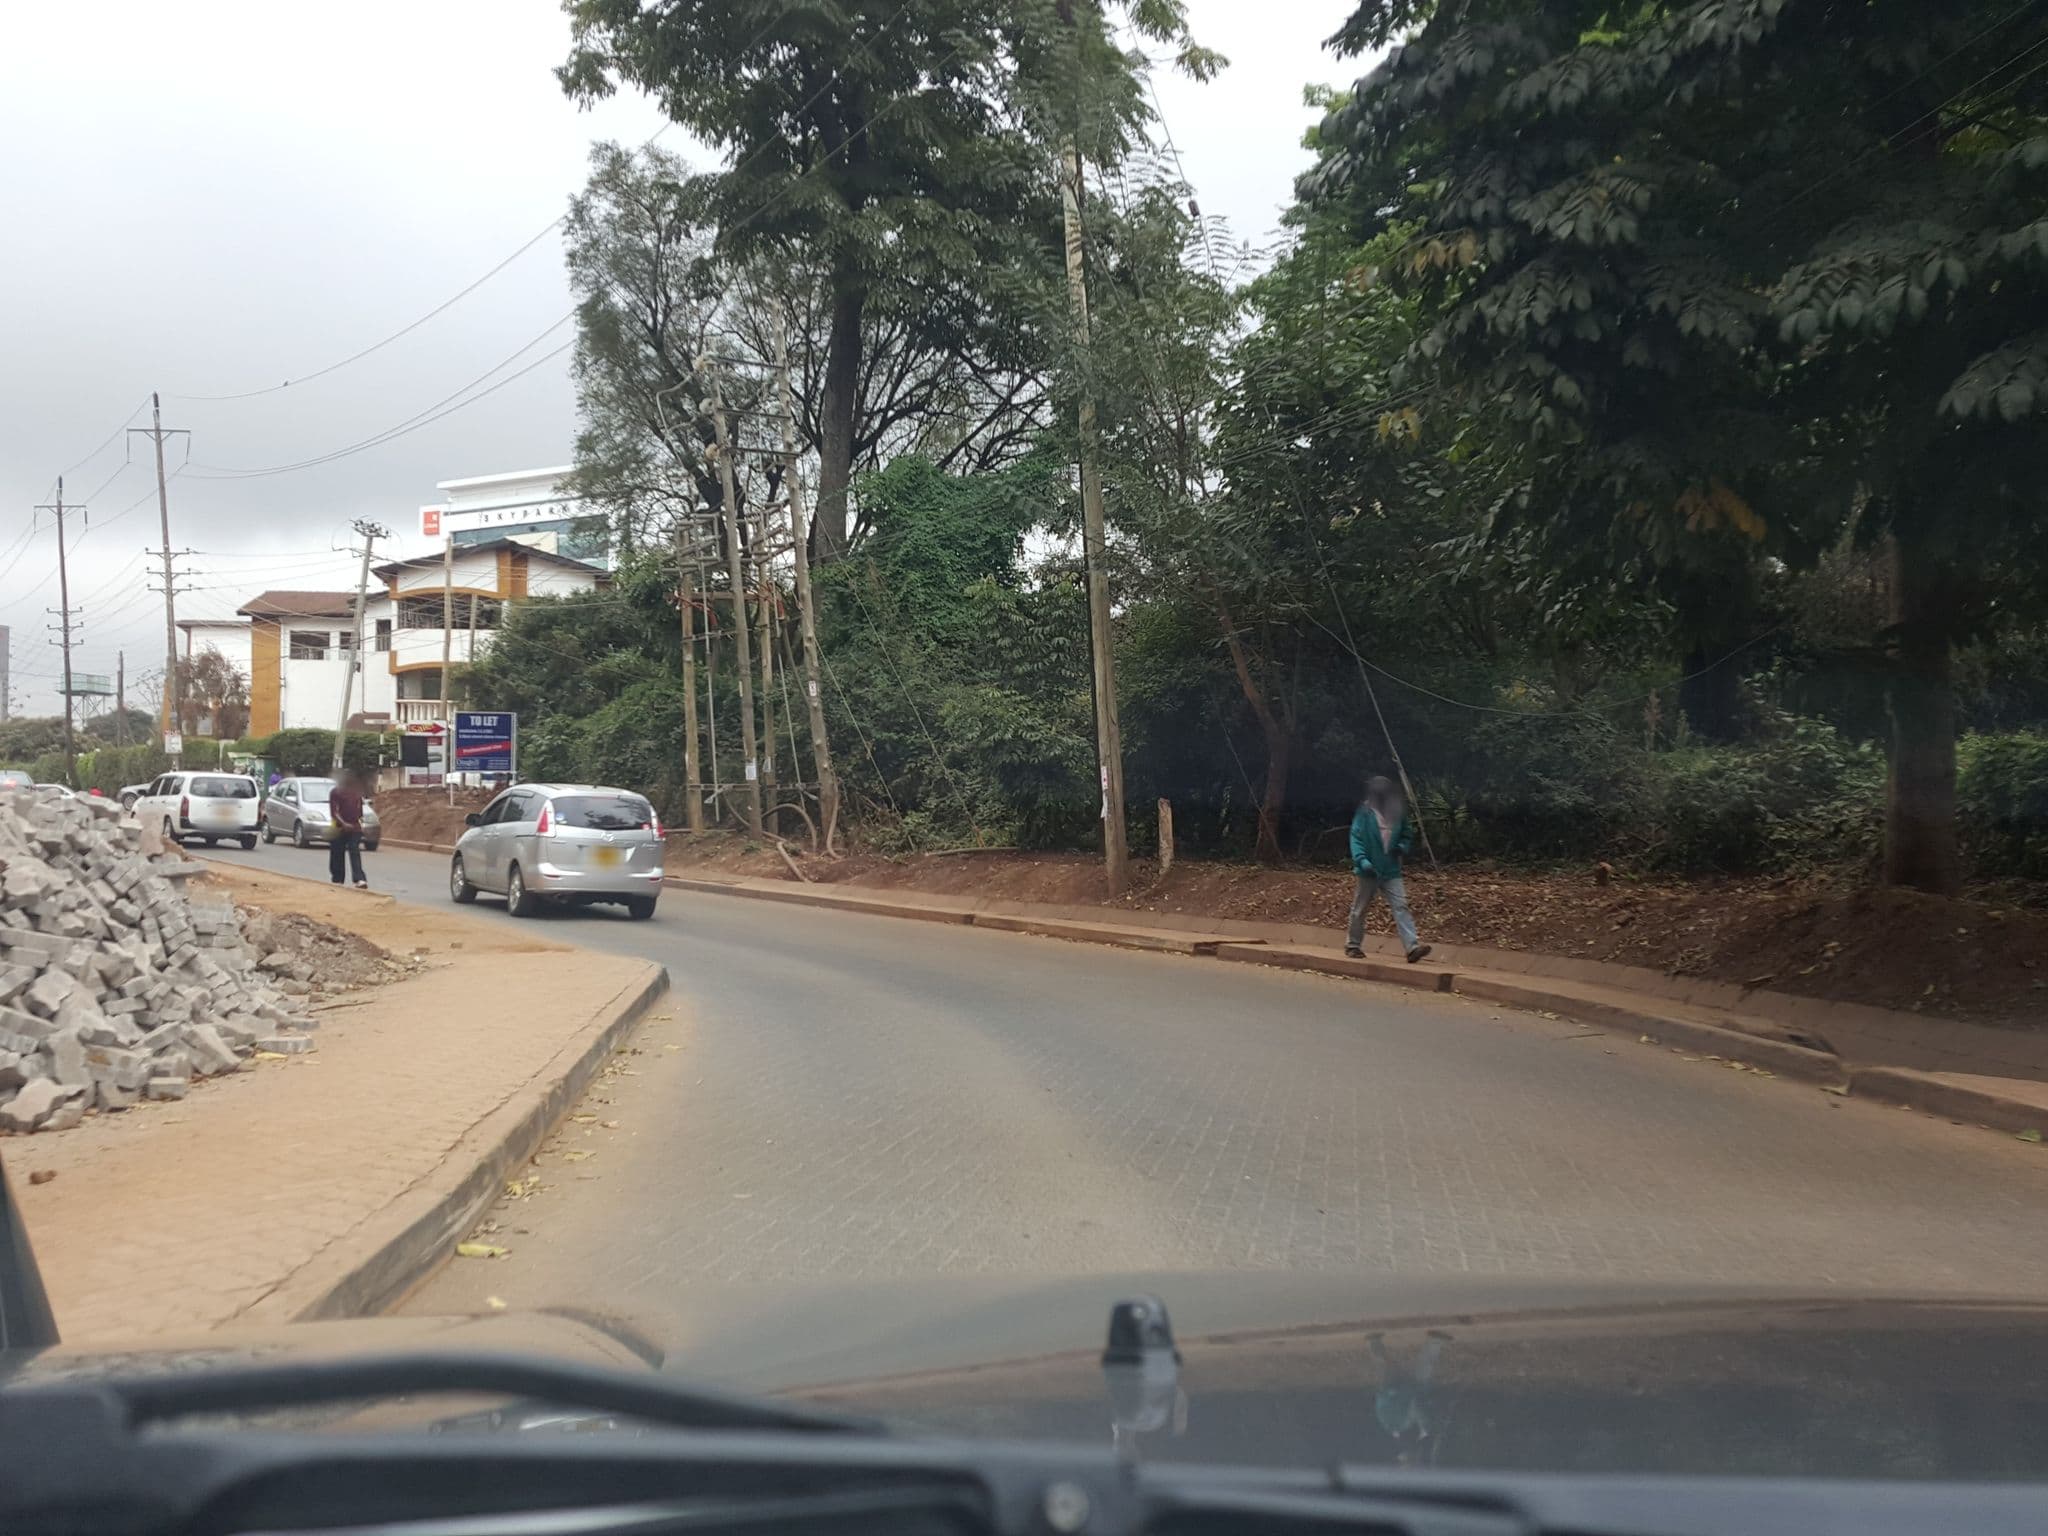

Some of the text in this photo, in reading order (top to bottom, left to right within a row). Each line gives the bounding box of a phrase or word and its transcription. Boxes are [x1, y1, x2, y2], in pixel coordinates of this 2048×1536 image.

[484, 503, 569, 522] SKYPARK
[470, 715, 498, 726] TO LET
